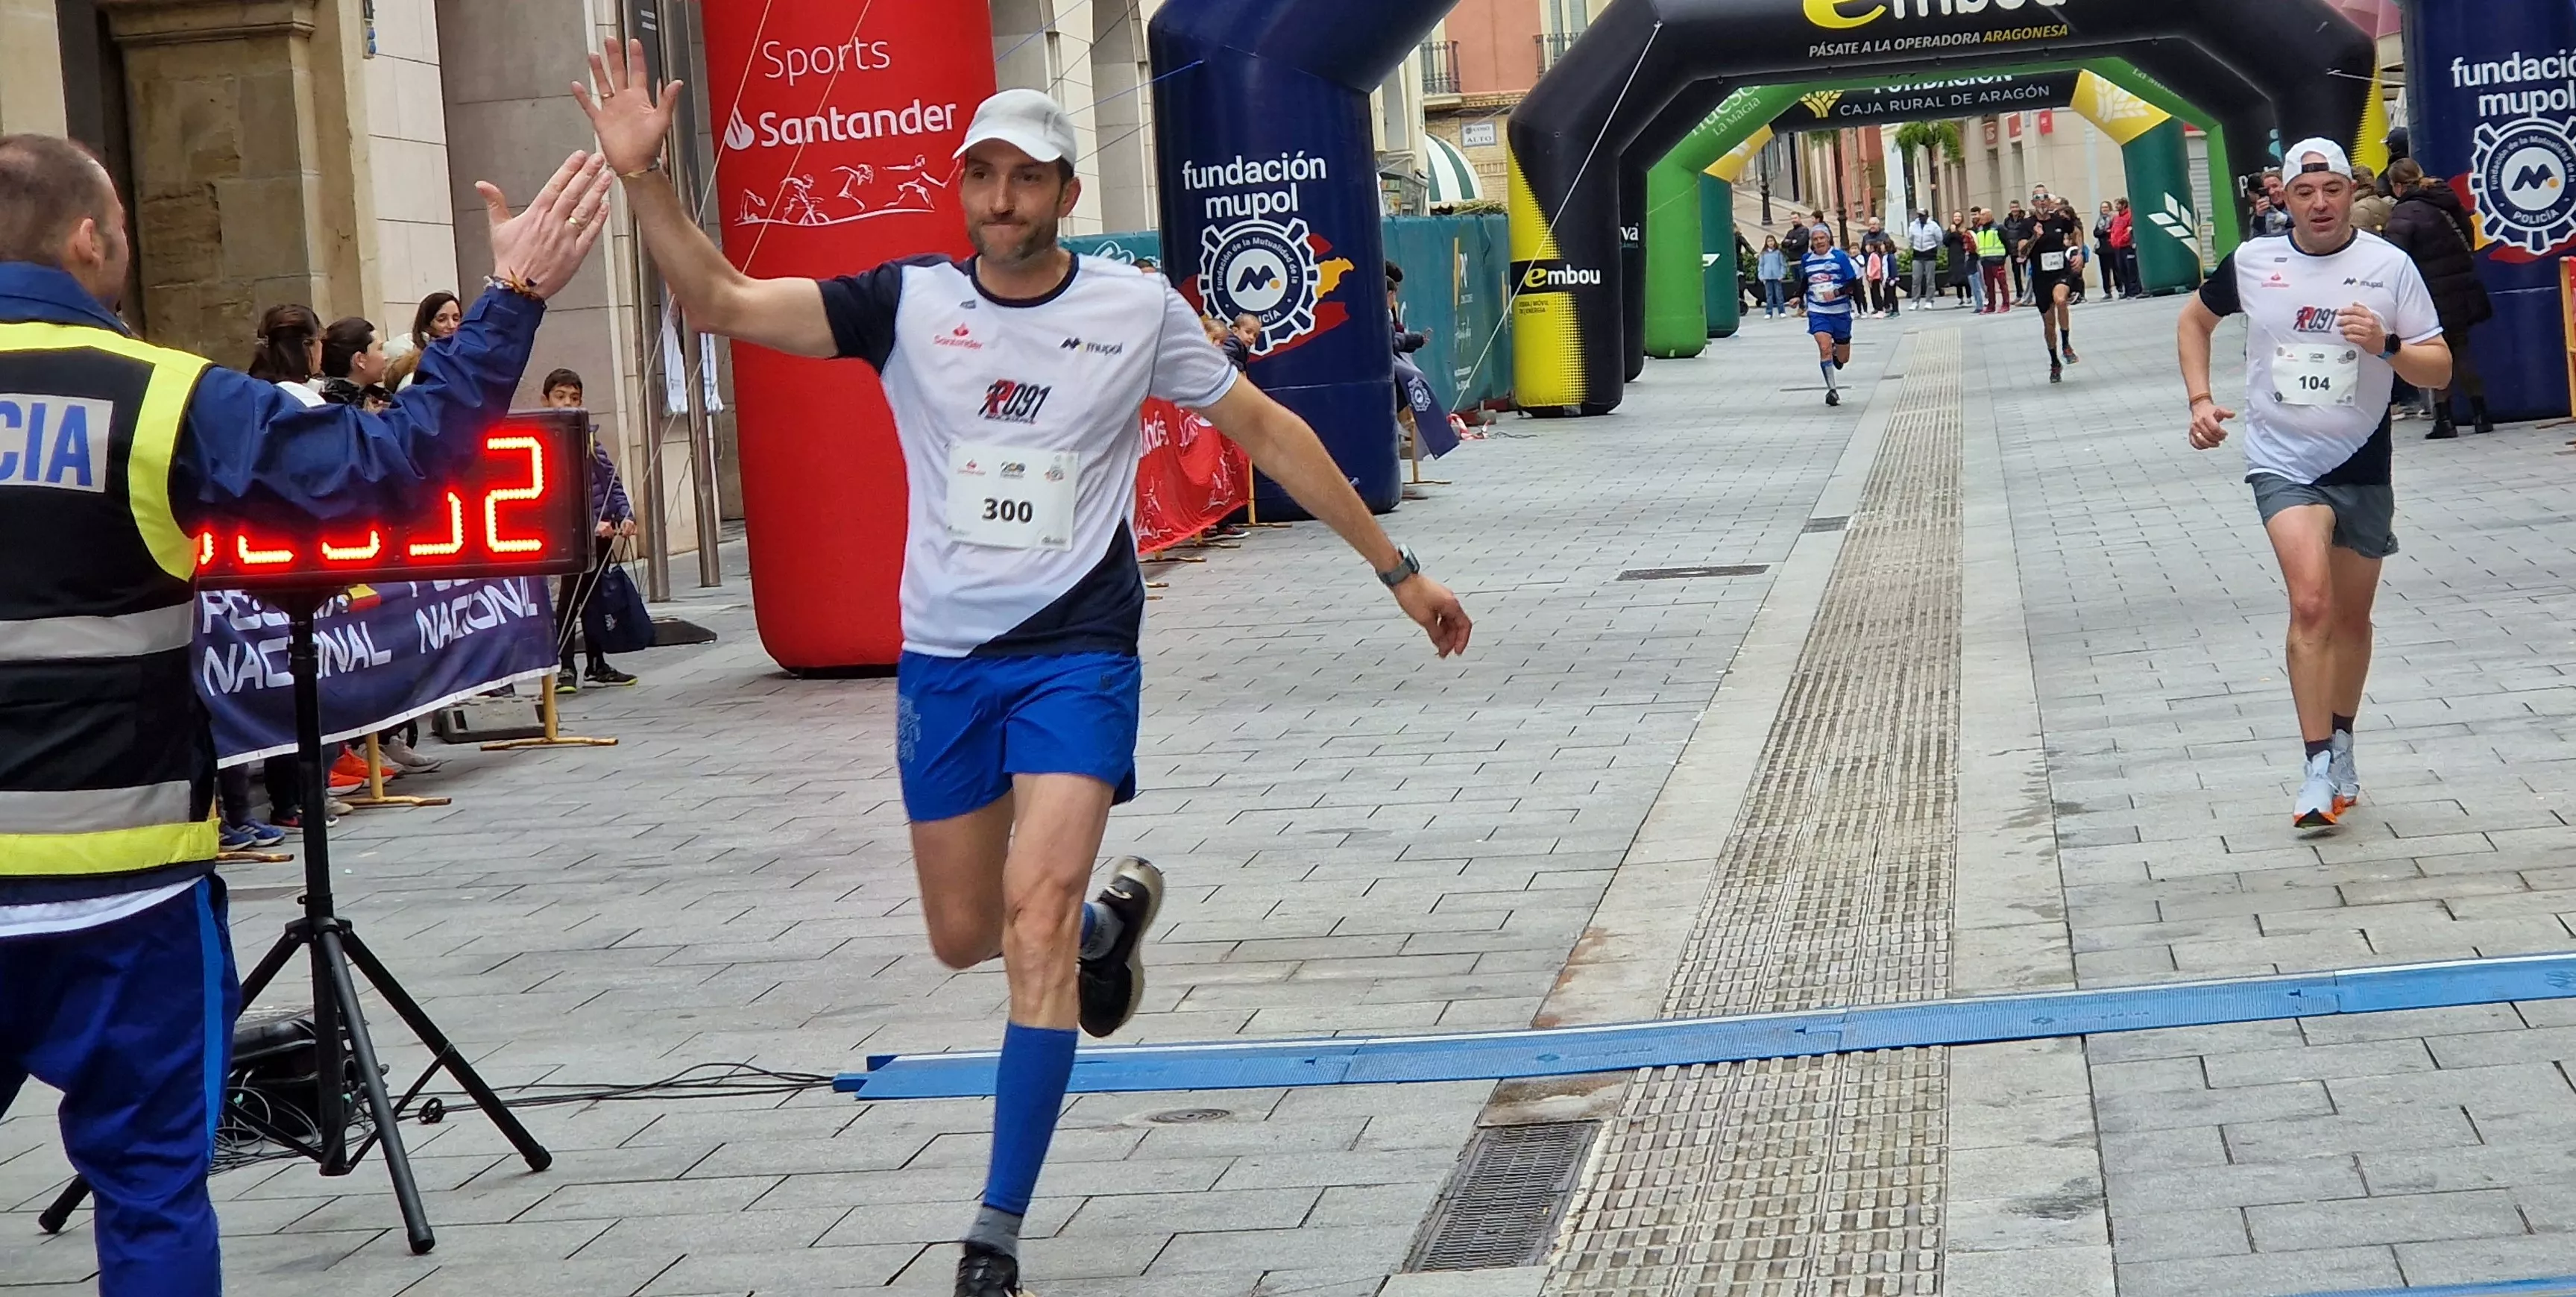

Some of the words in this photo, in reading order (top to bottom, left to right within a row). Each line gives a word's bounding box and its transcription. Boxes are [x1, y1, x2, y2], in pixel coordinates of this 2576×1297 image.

[1809, 41, 1859, 58] PÁSATE
[1861, 41, 1871, 54] A
[1874, 39, 1892, 53] LA
[1894, 32, 1981, 51] OPERADORA
[1983, 23, 2069, 43] ARAGONESA
[762, 37, 891, 87] Sports
[1839, 102, 1884, 117] CAJA
[1889, 96, 1945, 113] RURAL
[1950, 92, 1973, 106] DE
[1978, 84, 2050, 104] ARAGÓN
[2478, 79, 2576, 119] mupol
[759, 98, 957, 148] Santander
[1182, 150, 1326, 189] fundación
[1205, 182, 1299, 220] mupol
[2512, 208, 2560, 224] POLICÍA
[1232, 242, 1241, 252] de
[1216, 250, 1233, 292] Fundación
[1288, 262, 1297, 274] de
[1291, 276, 1300, 284] la
[1524, 263, 1602, 288] embou
[1086, 341, 1124, 357] mupol
[2298, 374, 2331, 391] 104
[981, 497, 1034, 524] 300
